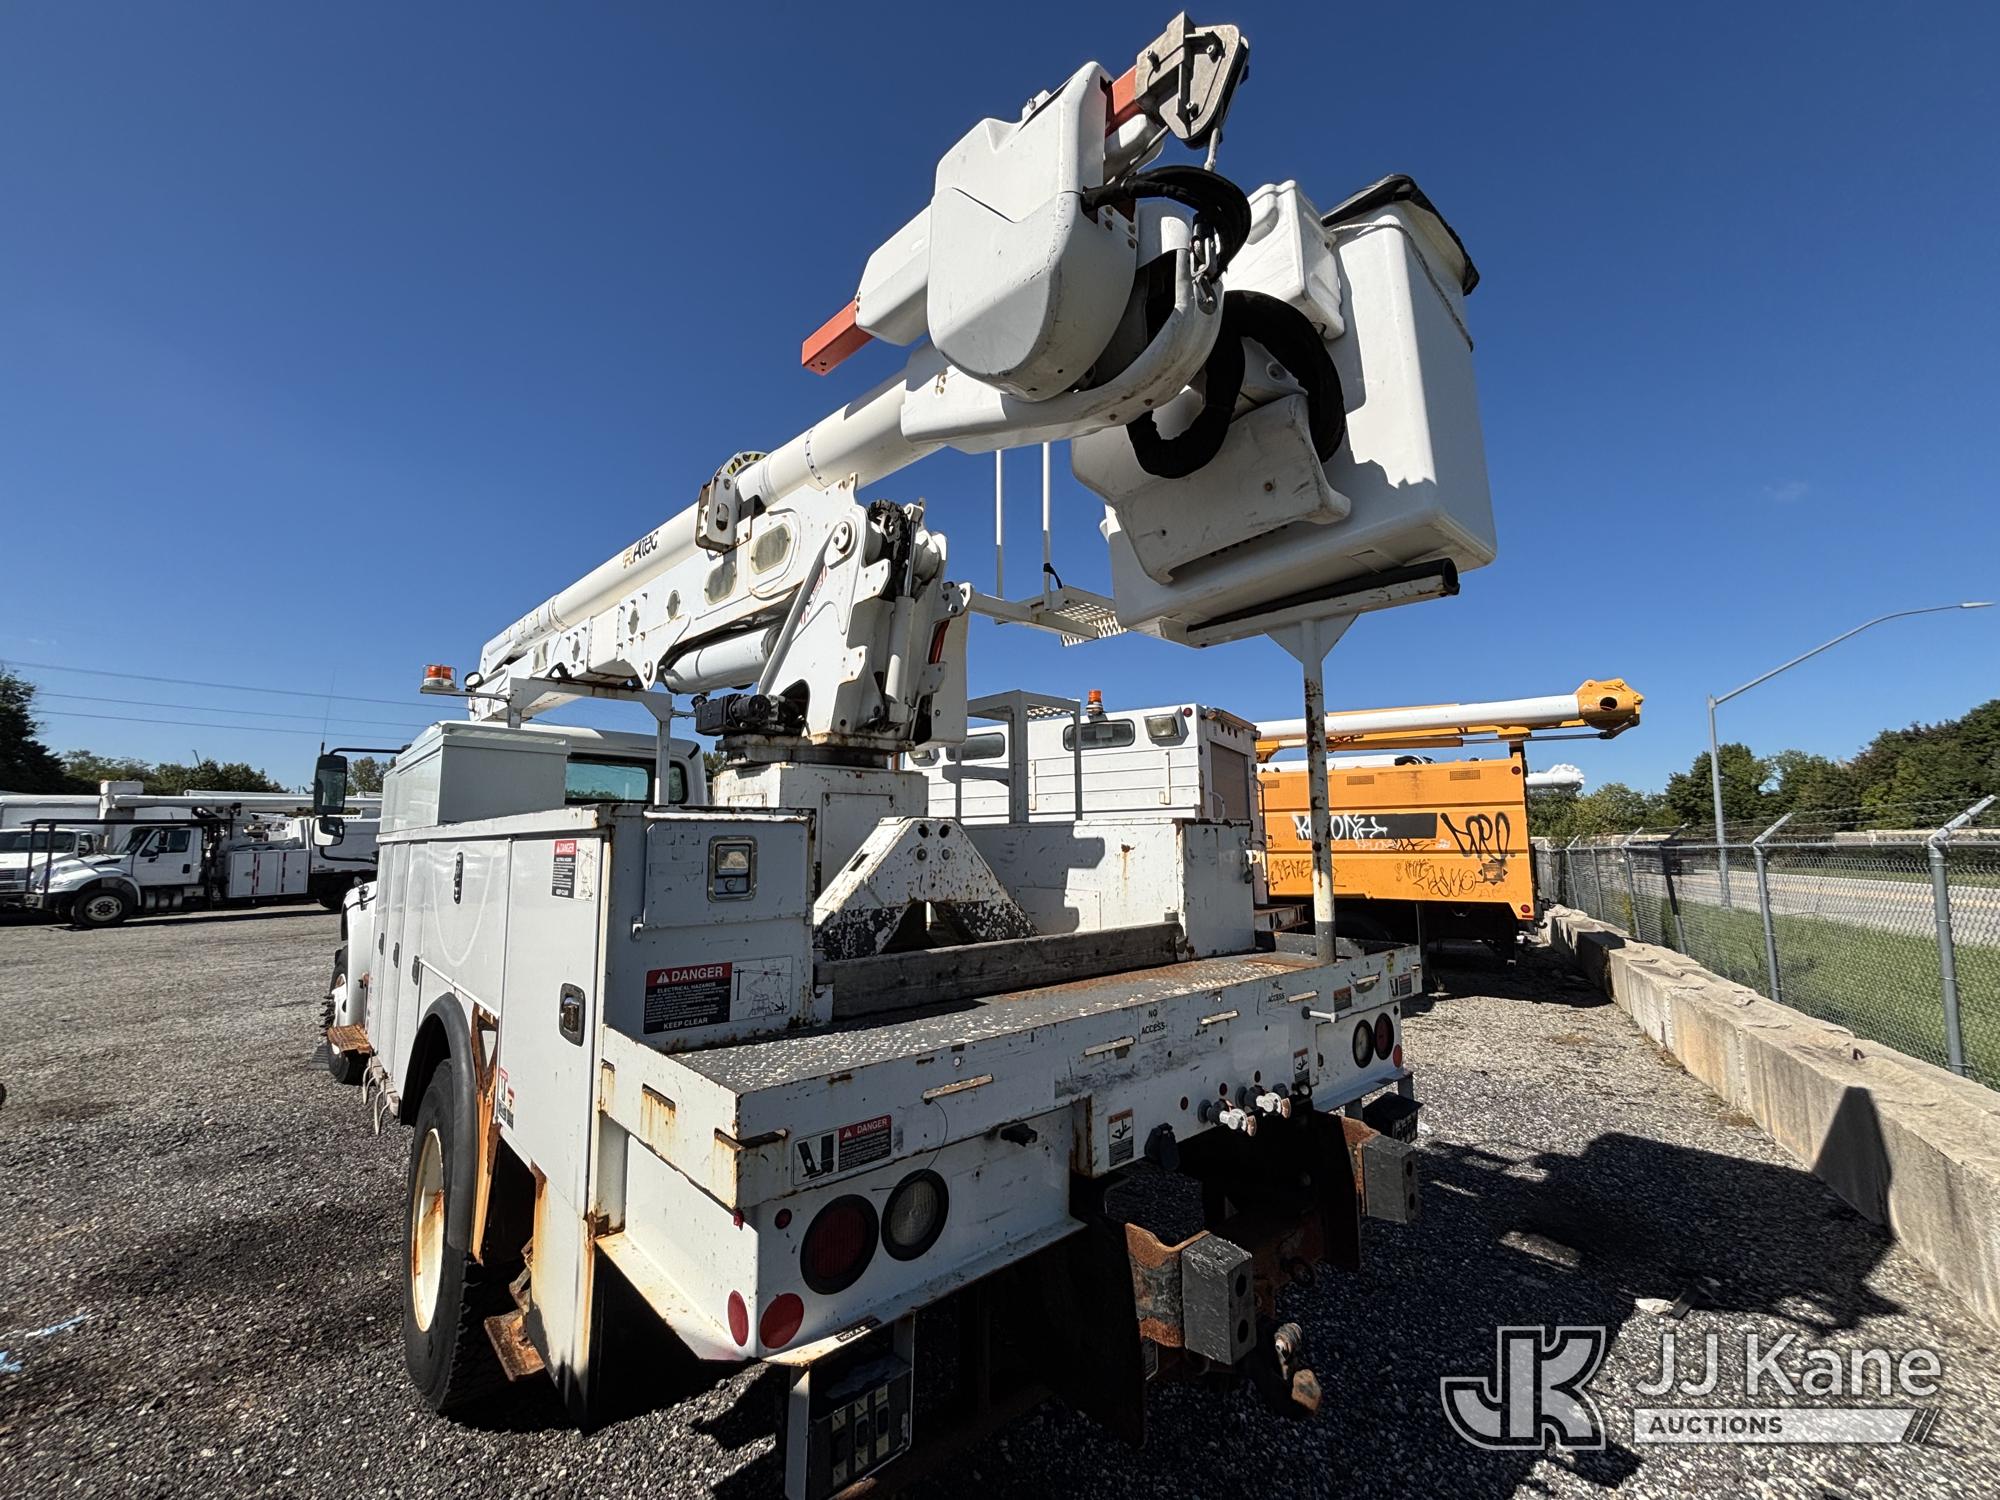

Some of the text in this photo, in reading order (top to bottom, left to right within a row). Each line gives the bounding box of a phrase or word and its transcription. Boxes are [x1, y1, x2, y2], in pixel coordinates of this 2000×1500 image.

[671, 966, 723, 982] DANGER
[1148, 1009, 1158, 1018] NO
[663, 1017, 708, 1029] KEEP CLEAR
[1141, 1021, 1166, 1035] ACCESS
[856, 1118, 888, 1134] DANGER
